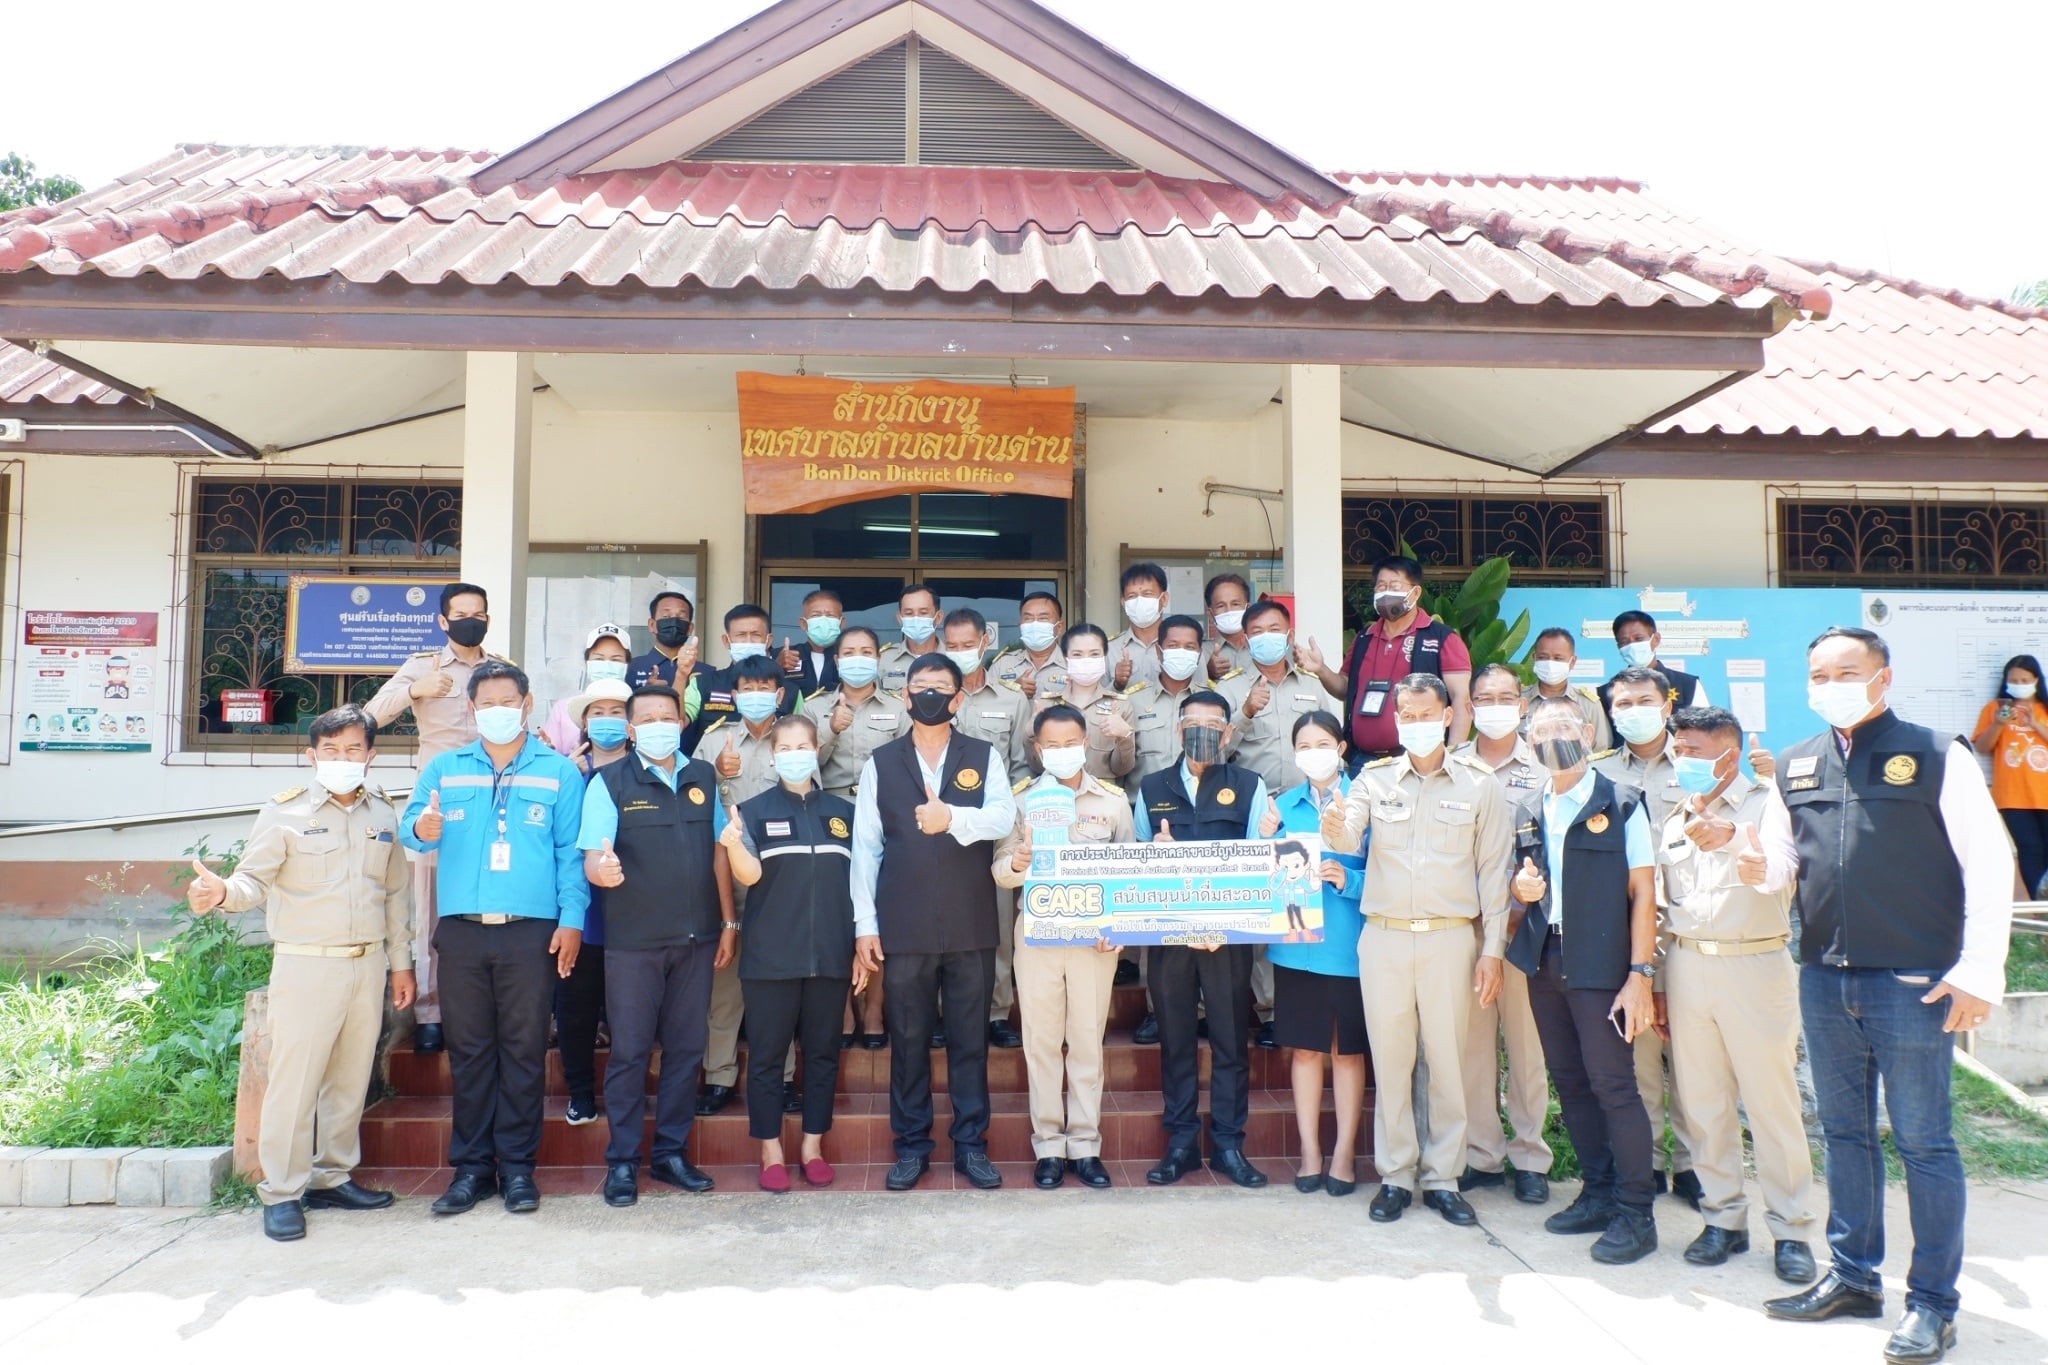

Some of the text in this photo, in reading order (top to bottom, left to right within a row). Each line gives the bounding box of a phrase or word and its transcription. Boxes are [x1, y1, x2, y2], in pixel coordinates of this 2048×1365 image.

[832, 381, 982, 424] สำนักงาน
[742, 423, 1073, 465] เทศบาลตำบลบ้านด่าน
[886, 464, 951, 483] District
[956, 465, 1015, 483] Office
[339, 609, 435, 625] ศูนย์รับเรื่องร้องทุกข์
[241, 710, 259, 722] 191
[1060, 843, 1271, 862] การประปาส่วนภูมิภาคสาขาอรัญประเทศ
[1060, 866, 1098, 876] Provincial
[1100, 866, 1143, 876] Waterworks
[1145, 865, 1180, 875] Authority
[1242, 863, 1270, 872] Branch
[1029, 885, 1103, 916] CARE
[1113, 879, 1271, 908] สนับสนุนน้ำดื่มสะอาด
